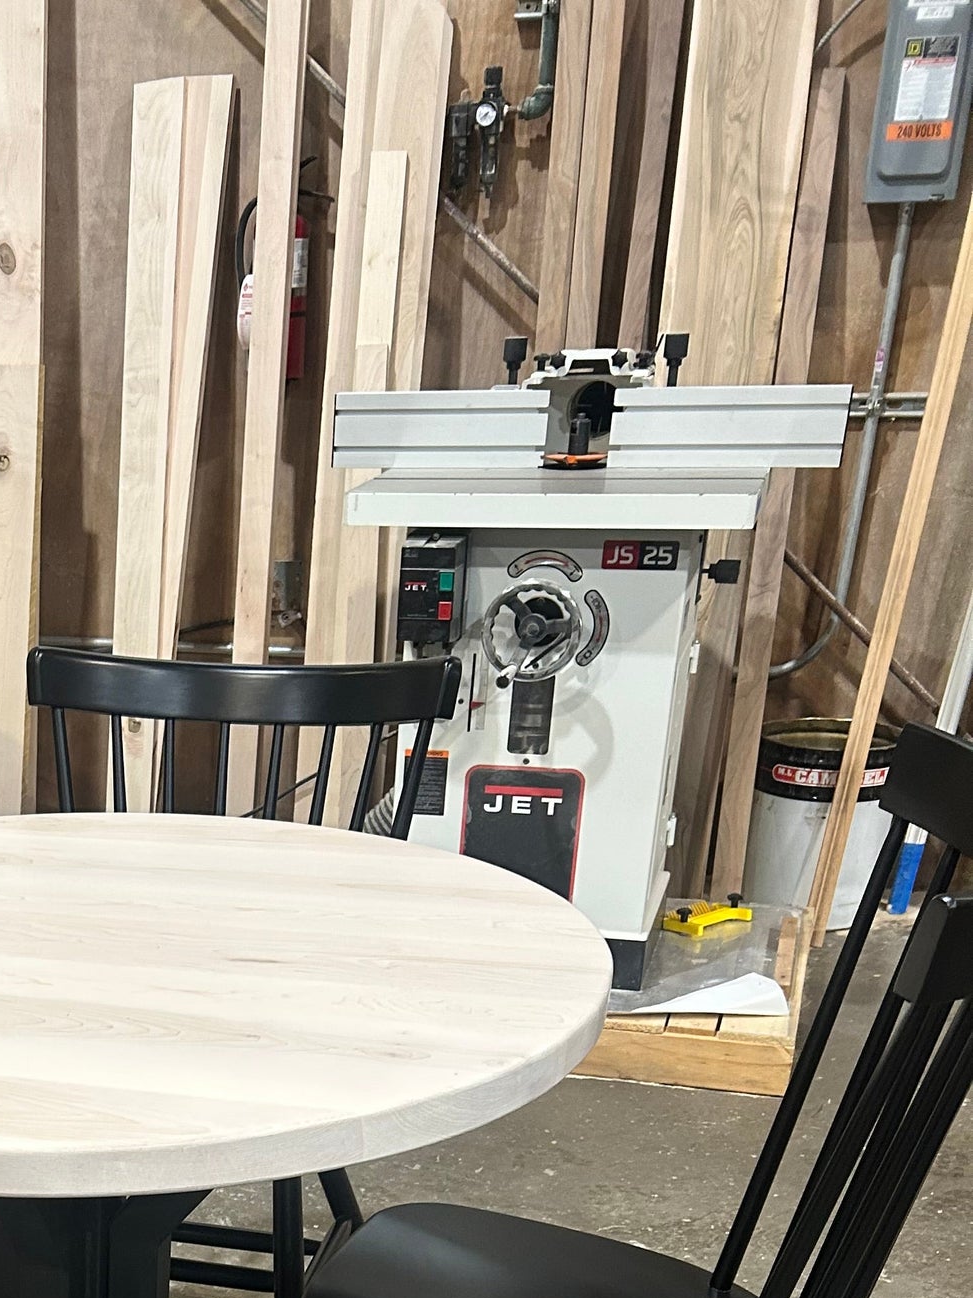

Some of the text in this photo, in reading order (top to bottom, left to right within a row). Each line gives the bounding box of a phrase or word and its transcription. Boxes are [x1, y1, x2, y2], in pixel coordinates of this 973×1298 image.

[897, 123, 942, 138] 240 VOLTS
[606, 545, 673, 565] JS 25
[404, 584, 428, 592] JET
[795, 769, 889, 785] CAMEL
[483, 794, 563, 816] JET
